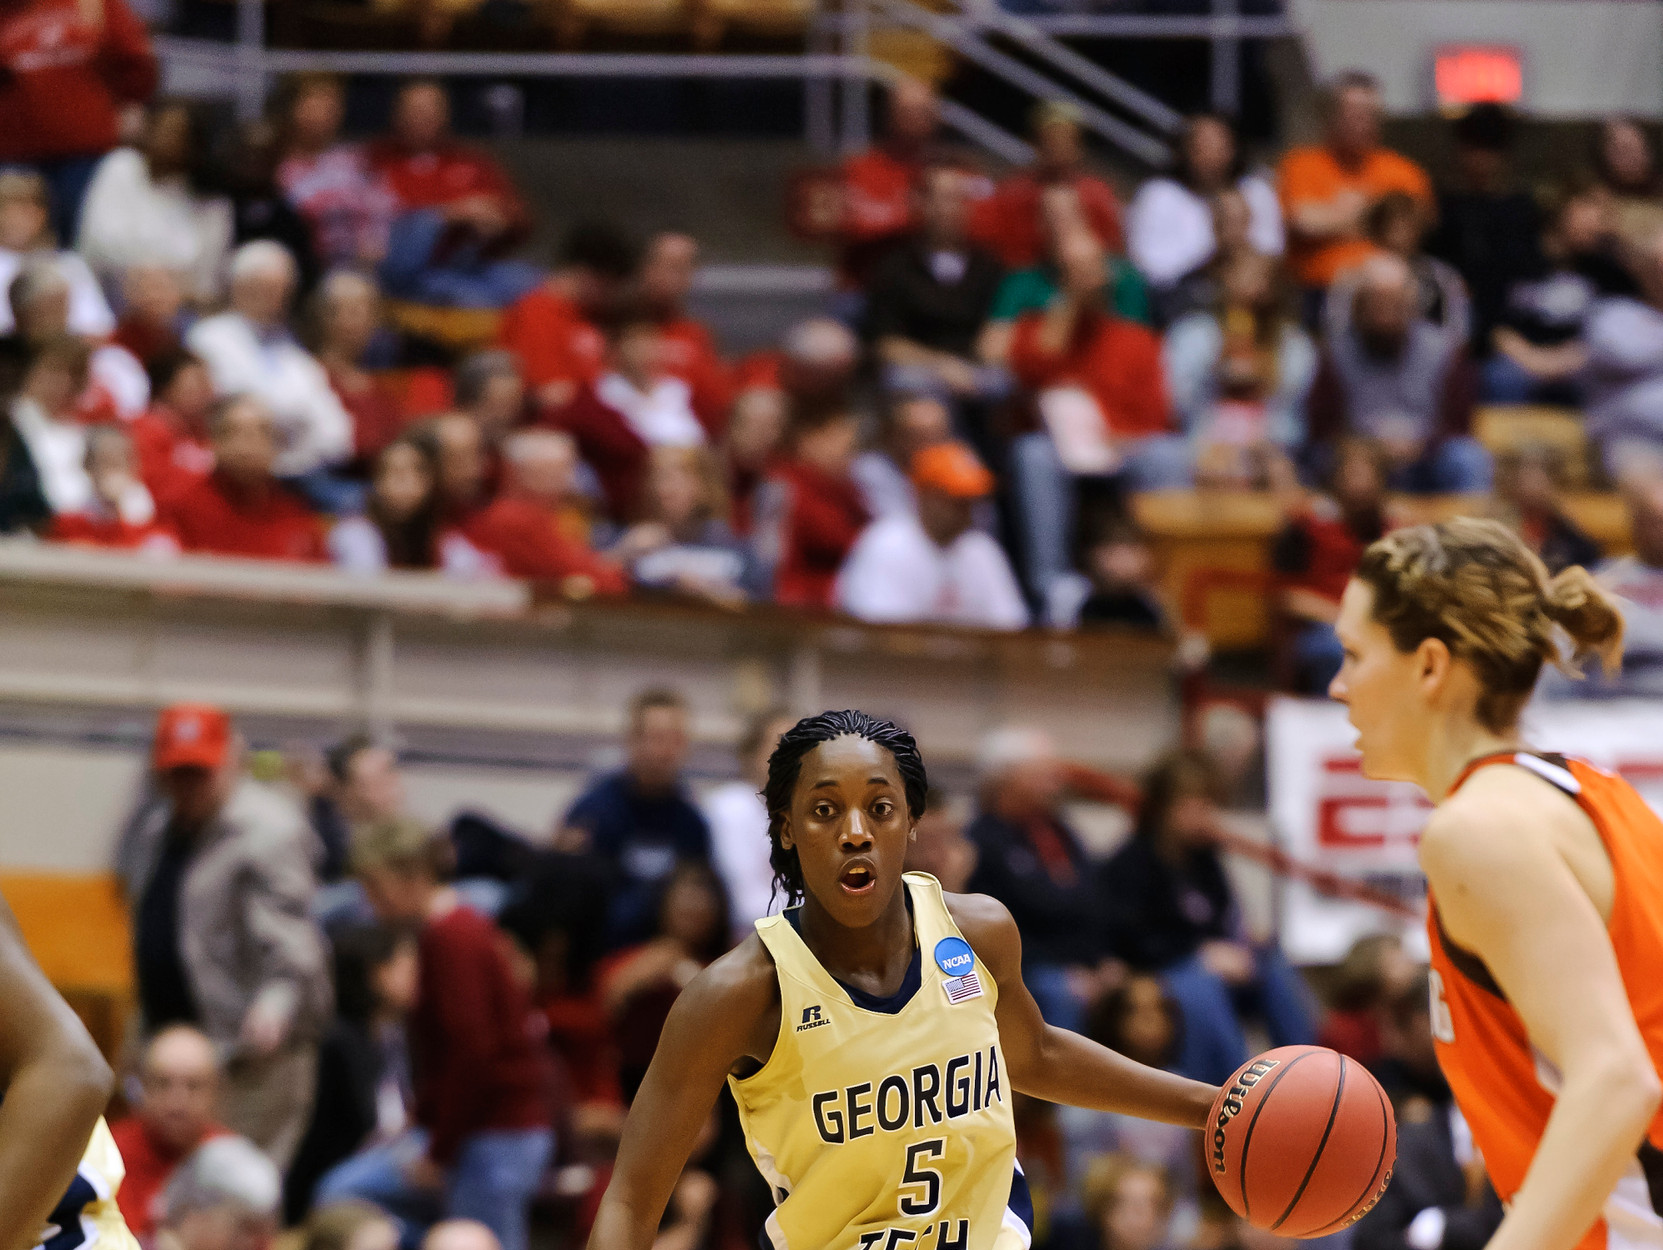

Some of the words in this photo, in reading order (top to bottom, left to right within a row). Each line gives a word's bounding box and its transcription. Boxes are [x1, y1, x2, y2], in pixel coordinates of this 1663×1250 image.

[942, 953, 972, 970] NCAA
[796, 1018, 831, 1032] RUSSELL
[812, 1044, 1002, 1144] GEORGIA
[1213, 1058, 1281, 1175] Wilson
[897, 1137, 947, 1217] 5
